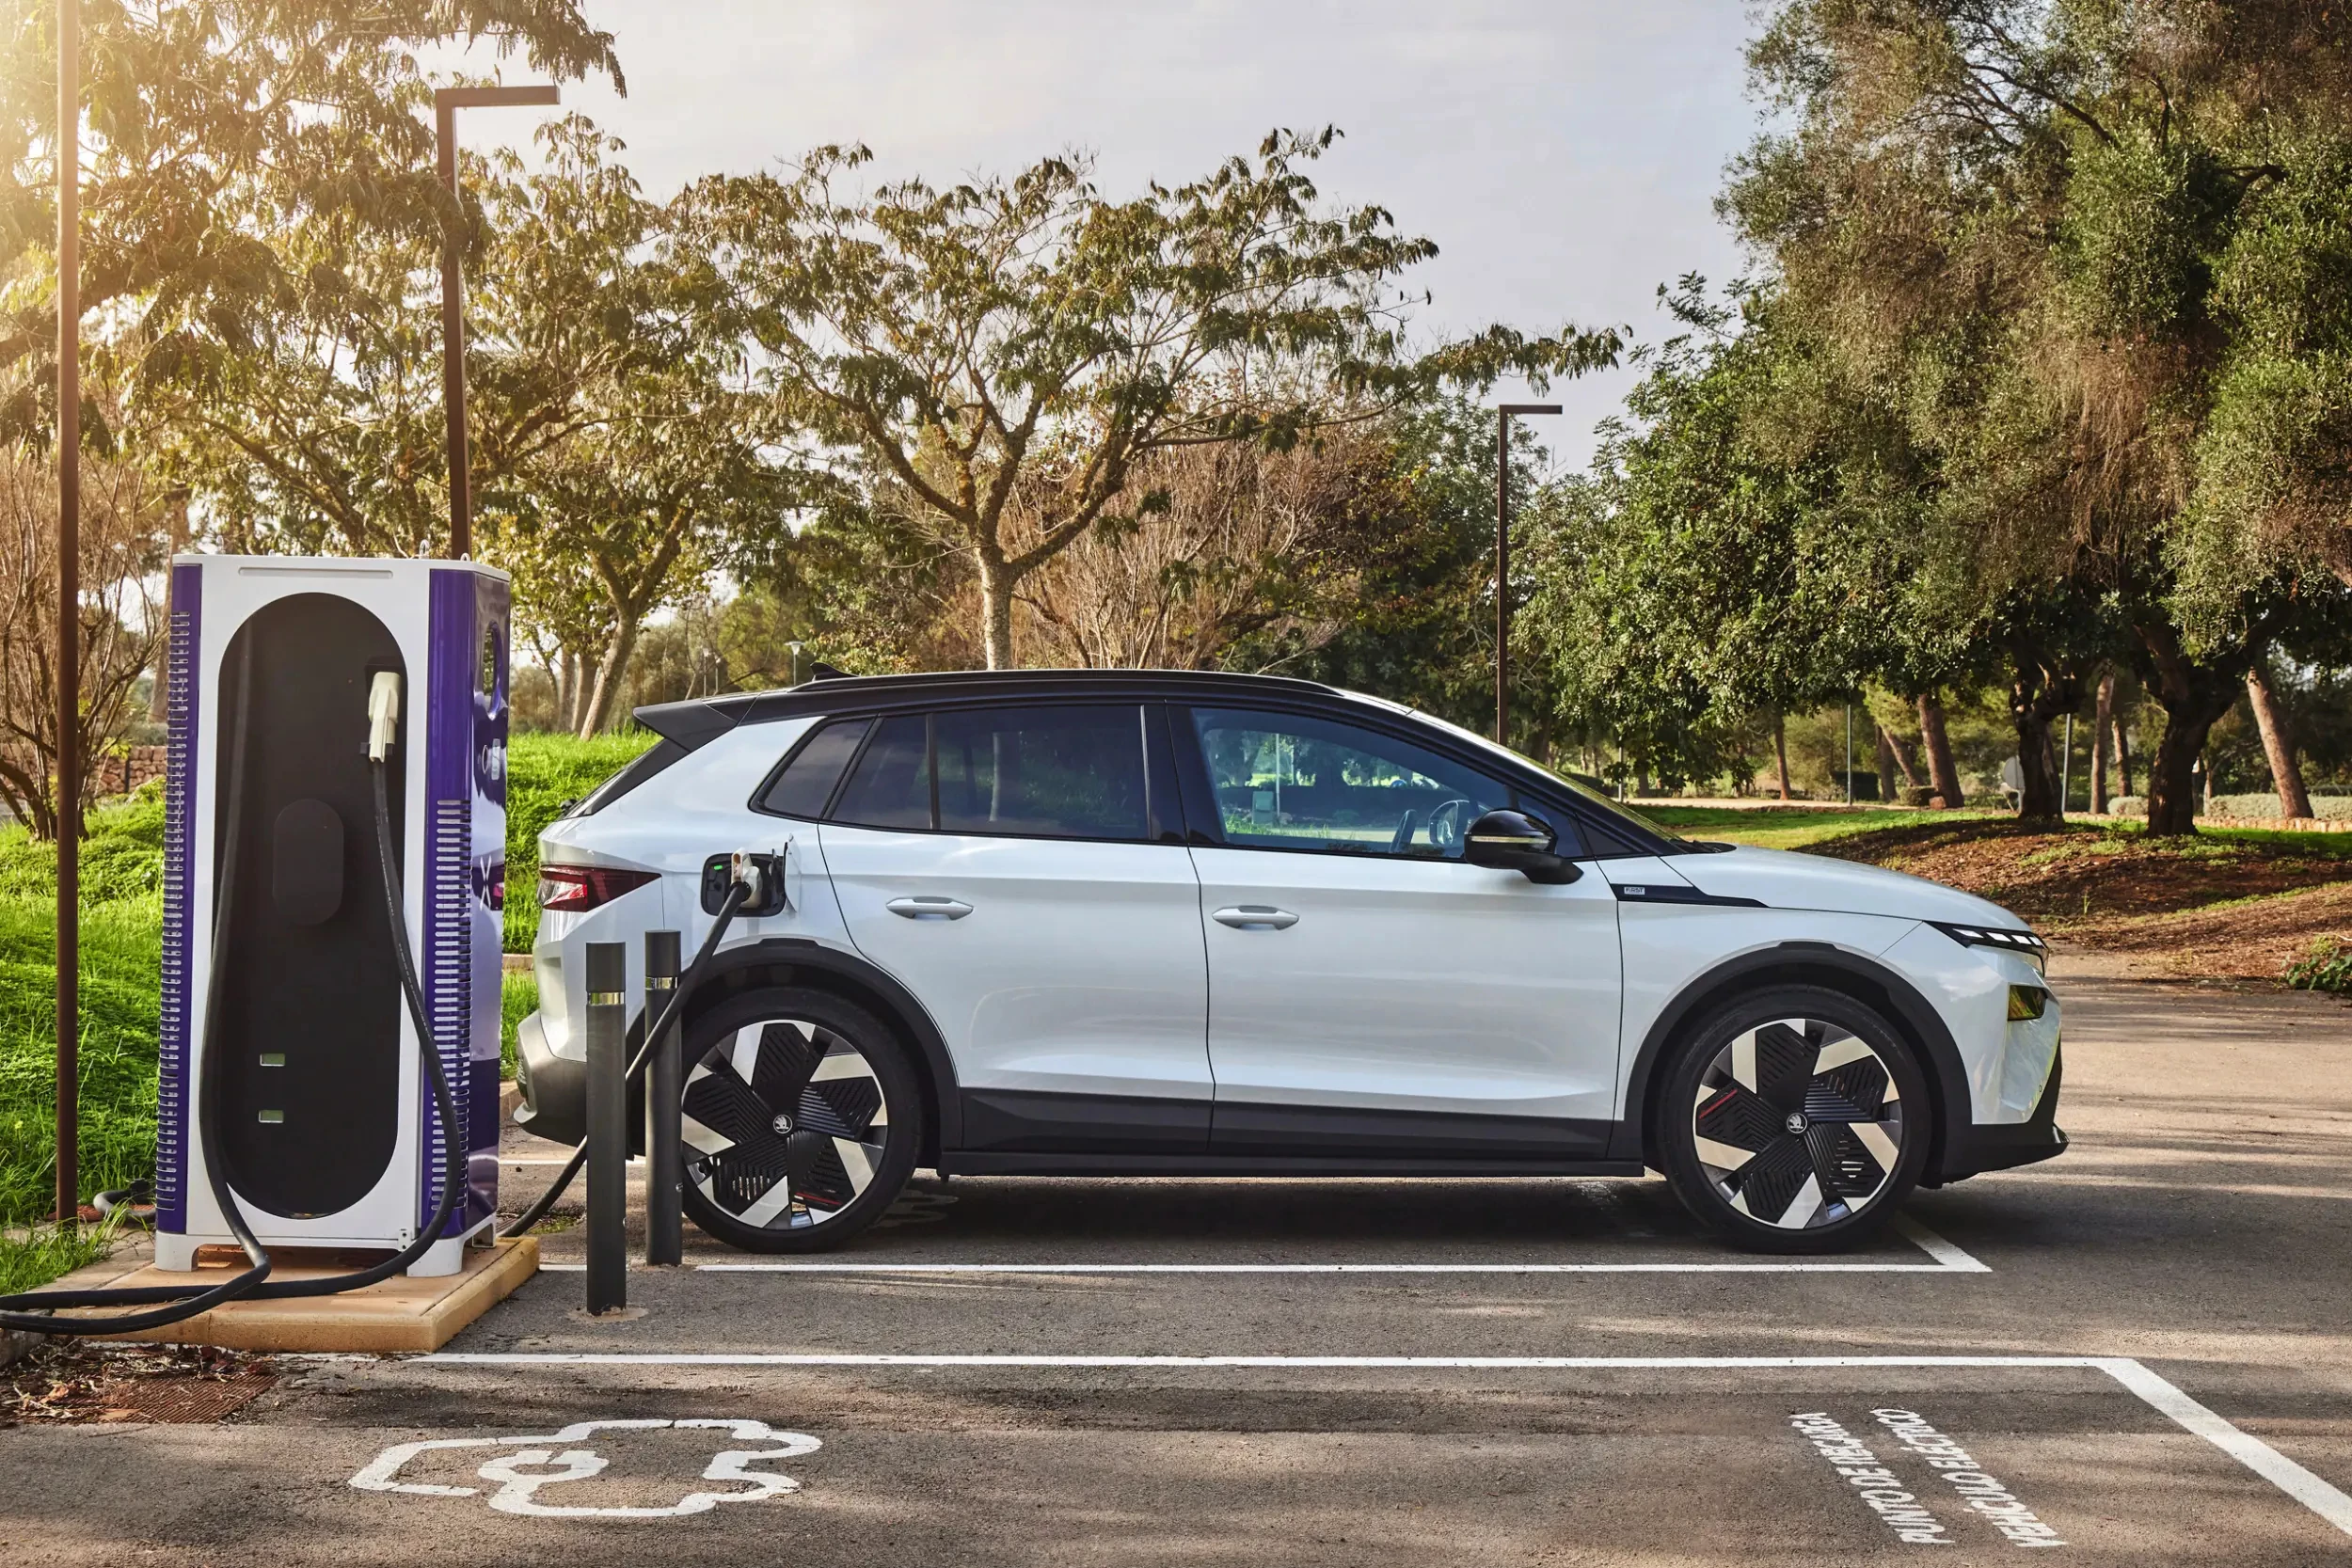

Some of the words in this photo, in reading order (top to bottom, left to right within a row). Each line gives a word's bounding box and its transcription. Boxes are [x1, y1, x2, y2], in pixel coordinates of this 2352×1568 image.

[1788, 1412, 1882, 1465] RECARGA
[1869, 1408, 1981, 1469] ELÉCTRICO
[1836, 1466, 1903, 1487] DE
[1860, 1489, 1956, 1544] PUNTO
[1941, 1472, 2069, 1547] VEHÍCULO
